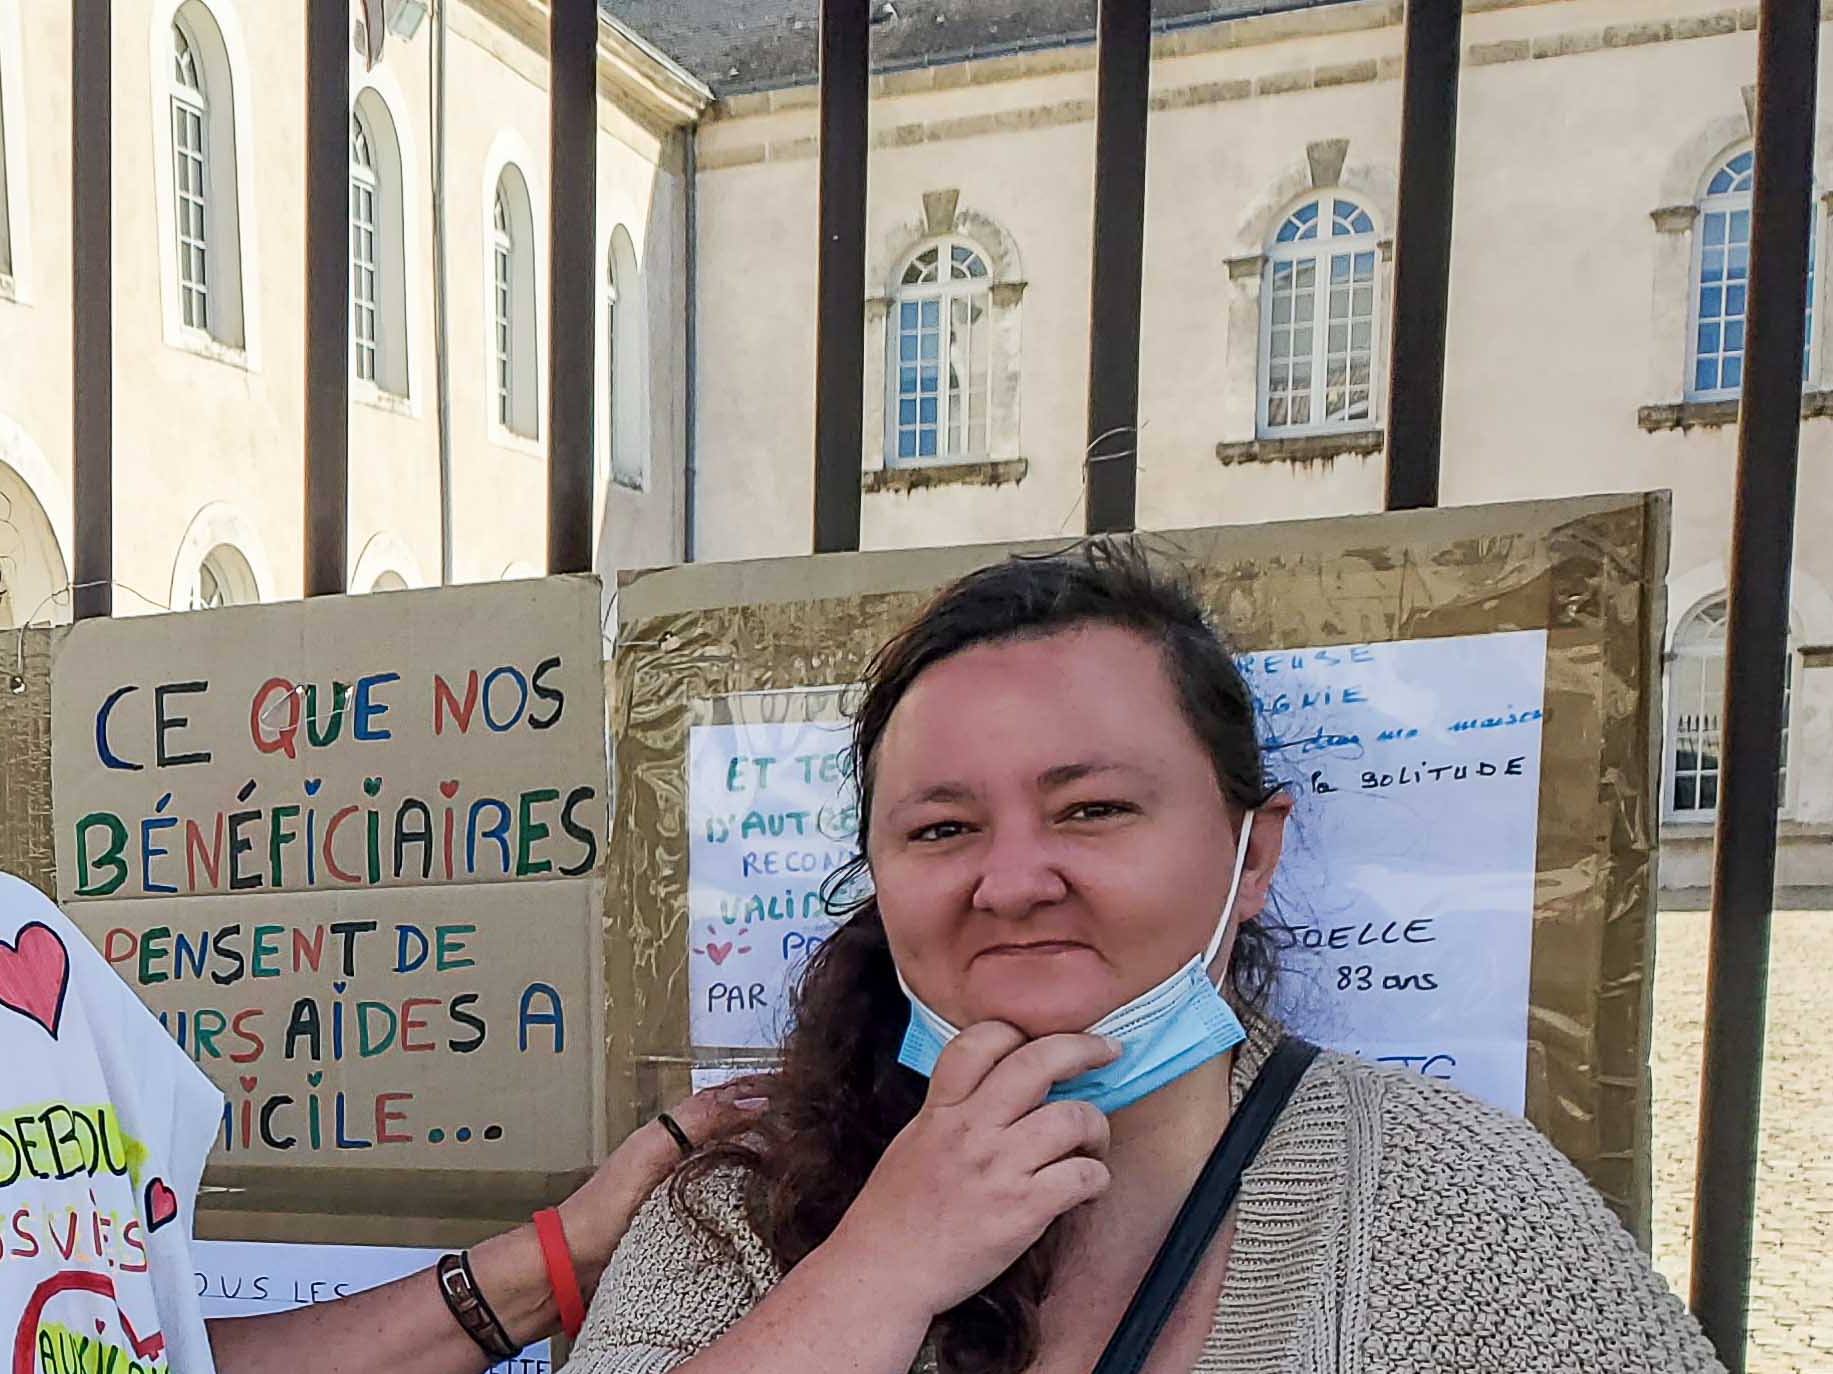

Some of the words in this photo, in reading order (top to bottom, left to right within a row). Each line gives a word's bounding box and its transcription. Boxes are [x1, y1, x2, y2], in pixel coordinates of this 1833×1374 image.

[95, 680, 212, 770] CE
[249, 672, 401, 759] QUE
[433, 655, 566, 737] NOS
[726, 756, 777, 793] ET
[104, 920, 377, 986] PENSENT
[392, 924, 476, 974] DE
[1336, 964, 1372, 991] 83
[1382, 971, 1439, 991] ans
[518, 981, 567, 1053] A
[708, 980, 769, 1013] PAR
